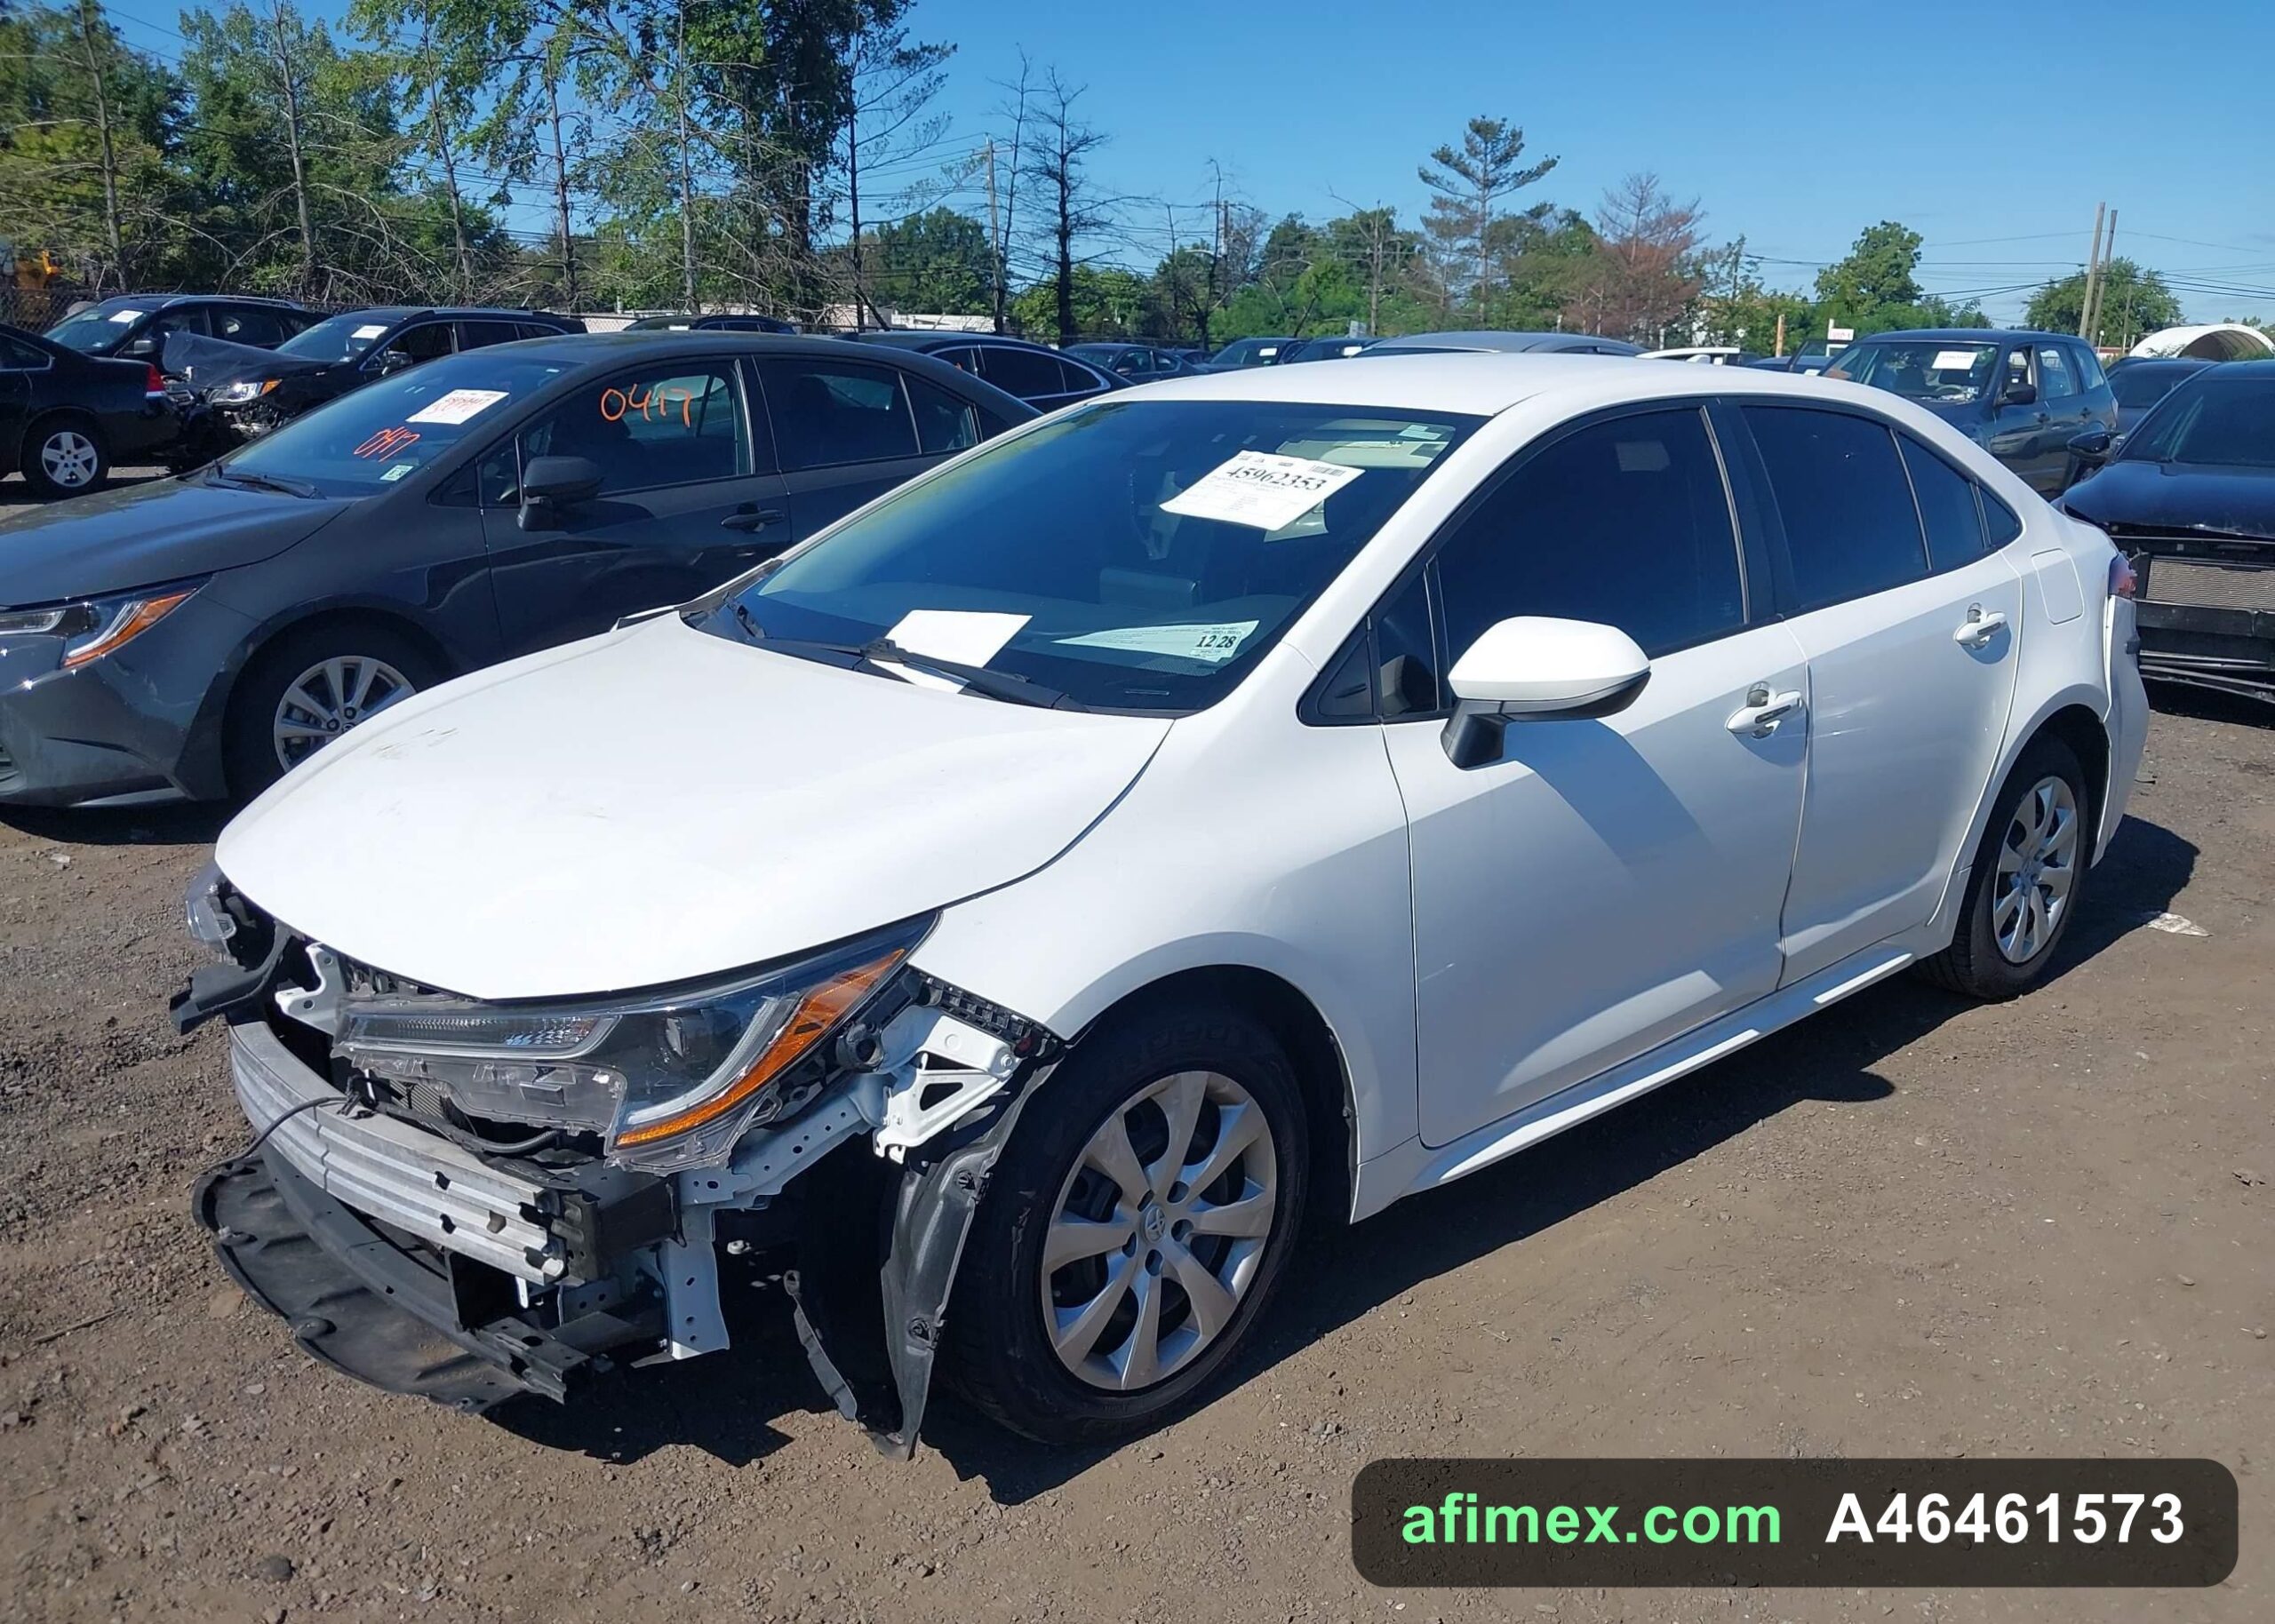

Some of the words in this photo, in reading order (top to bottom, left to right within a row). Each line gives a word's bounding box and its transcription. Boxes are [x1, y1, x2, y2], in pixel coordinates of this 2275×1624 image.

[601, 383, 692, 427] 0417
[1226, 466, 1327, 490] 45962353
[1195, 634, 1217, 648] 12
[1216, 635, 1237, 649] 28
